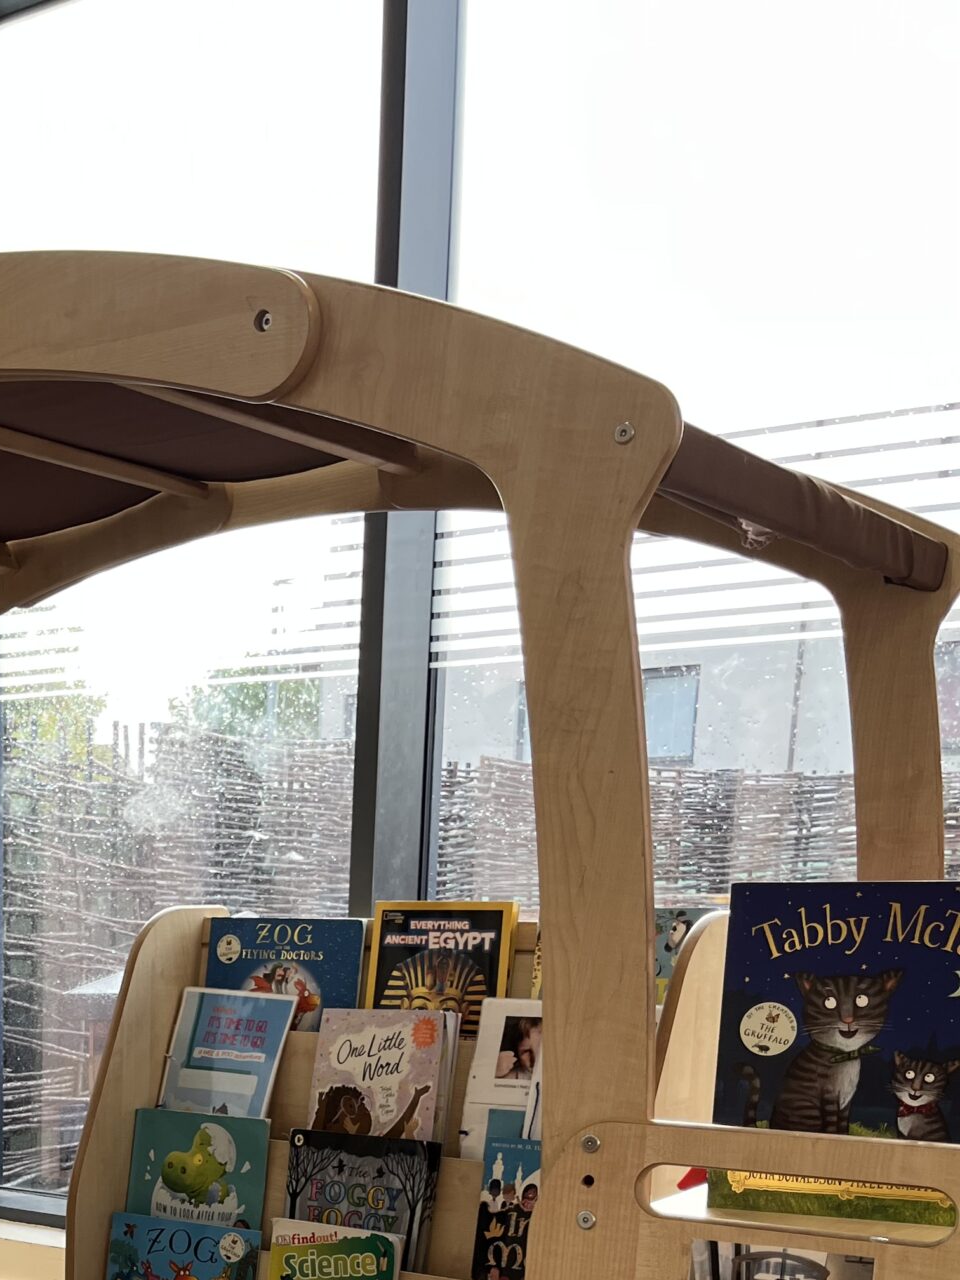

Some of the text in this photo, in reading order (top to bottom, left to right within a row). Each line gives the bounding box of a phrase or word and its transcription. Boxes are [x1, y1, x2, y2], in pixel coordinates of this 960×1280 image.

[255, 923, 313, 945] ZOG
[410, 920, 470, 930] EVERYTHING
[752, 902, 960, 960] Tabby McT
[384, 931, 496, 951] ANCIENT EGYPT
[242, 949, 324, 961] FLYING DOCTORS
[743, 1028, 789, 1045] GRUFFALO
[759, 1022, 777, 1033] THE
[337, 1039, 366, 1064] One
[367, 1031, 406, 1057] Little
[362, 1052, 405, 1082] Word
[347, 1166, 368, 1177] The
[308, 1178, 403, 1211] FOGGY
[170, 1205, 177, 1217] TO
[179, 1207, 194, 1219] LOOK
[196, 1210, 215, 1221] AFTER
[146, 1227, 220, 1264] ZOG
[291, 1231, 338, 1245] findout!
[283, 1249, 378, 1280] Science
